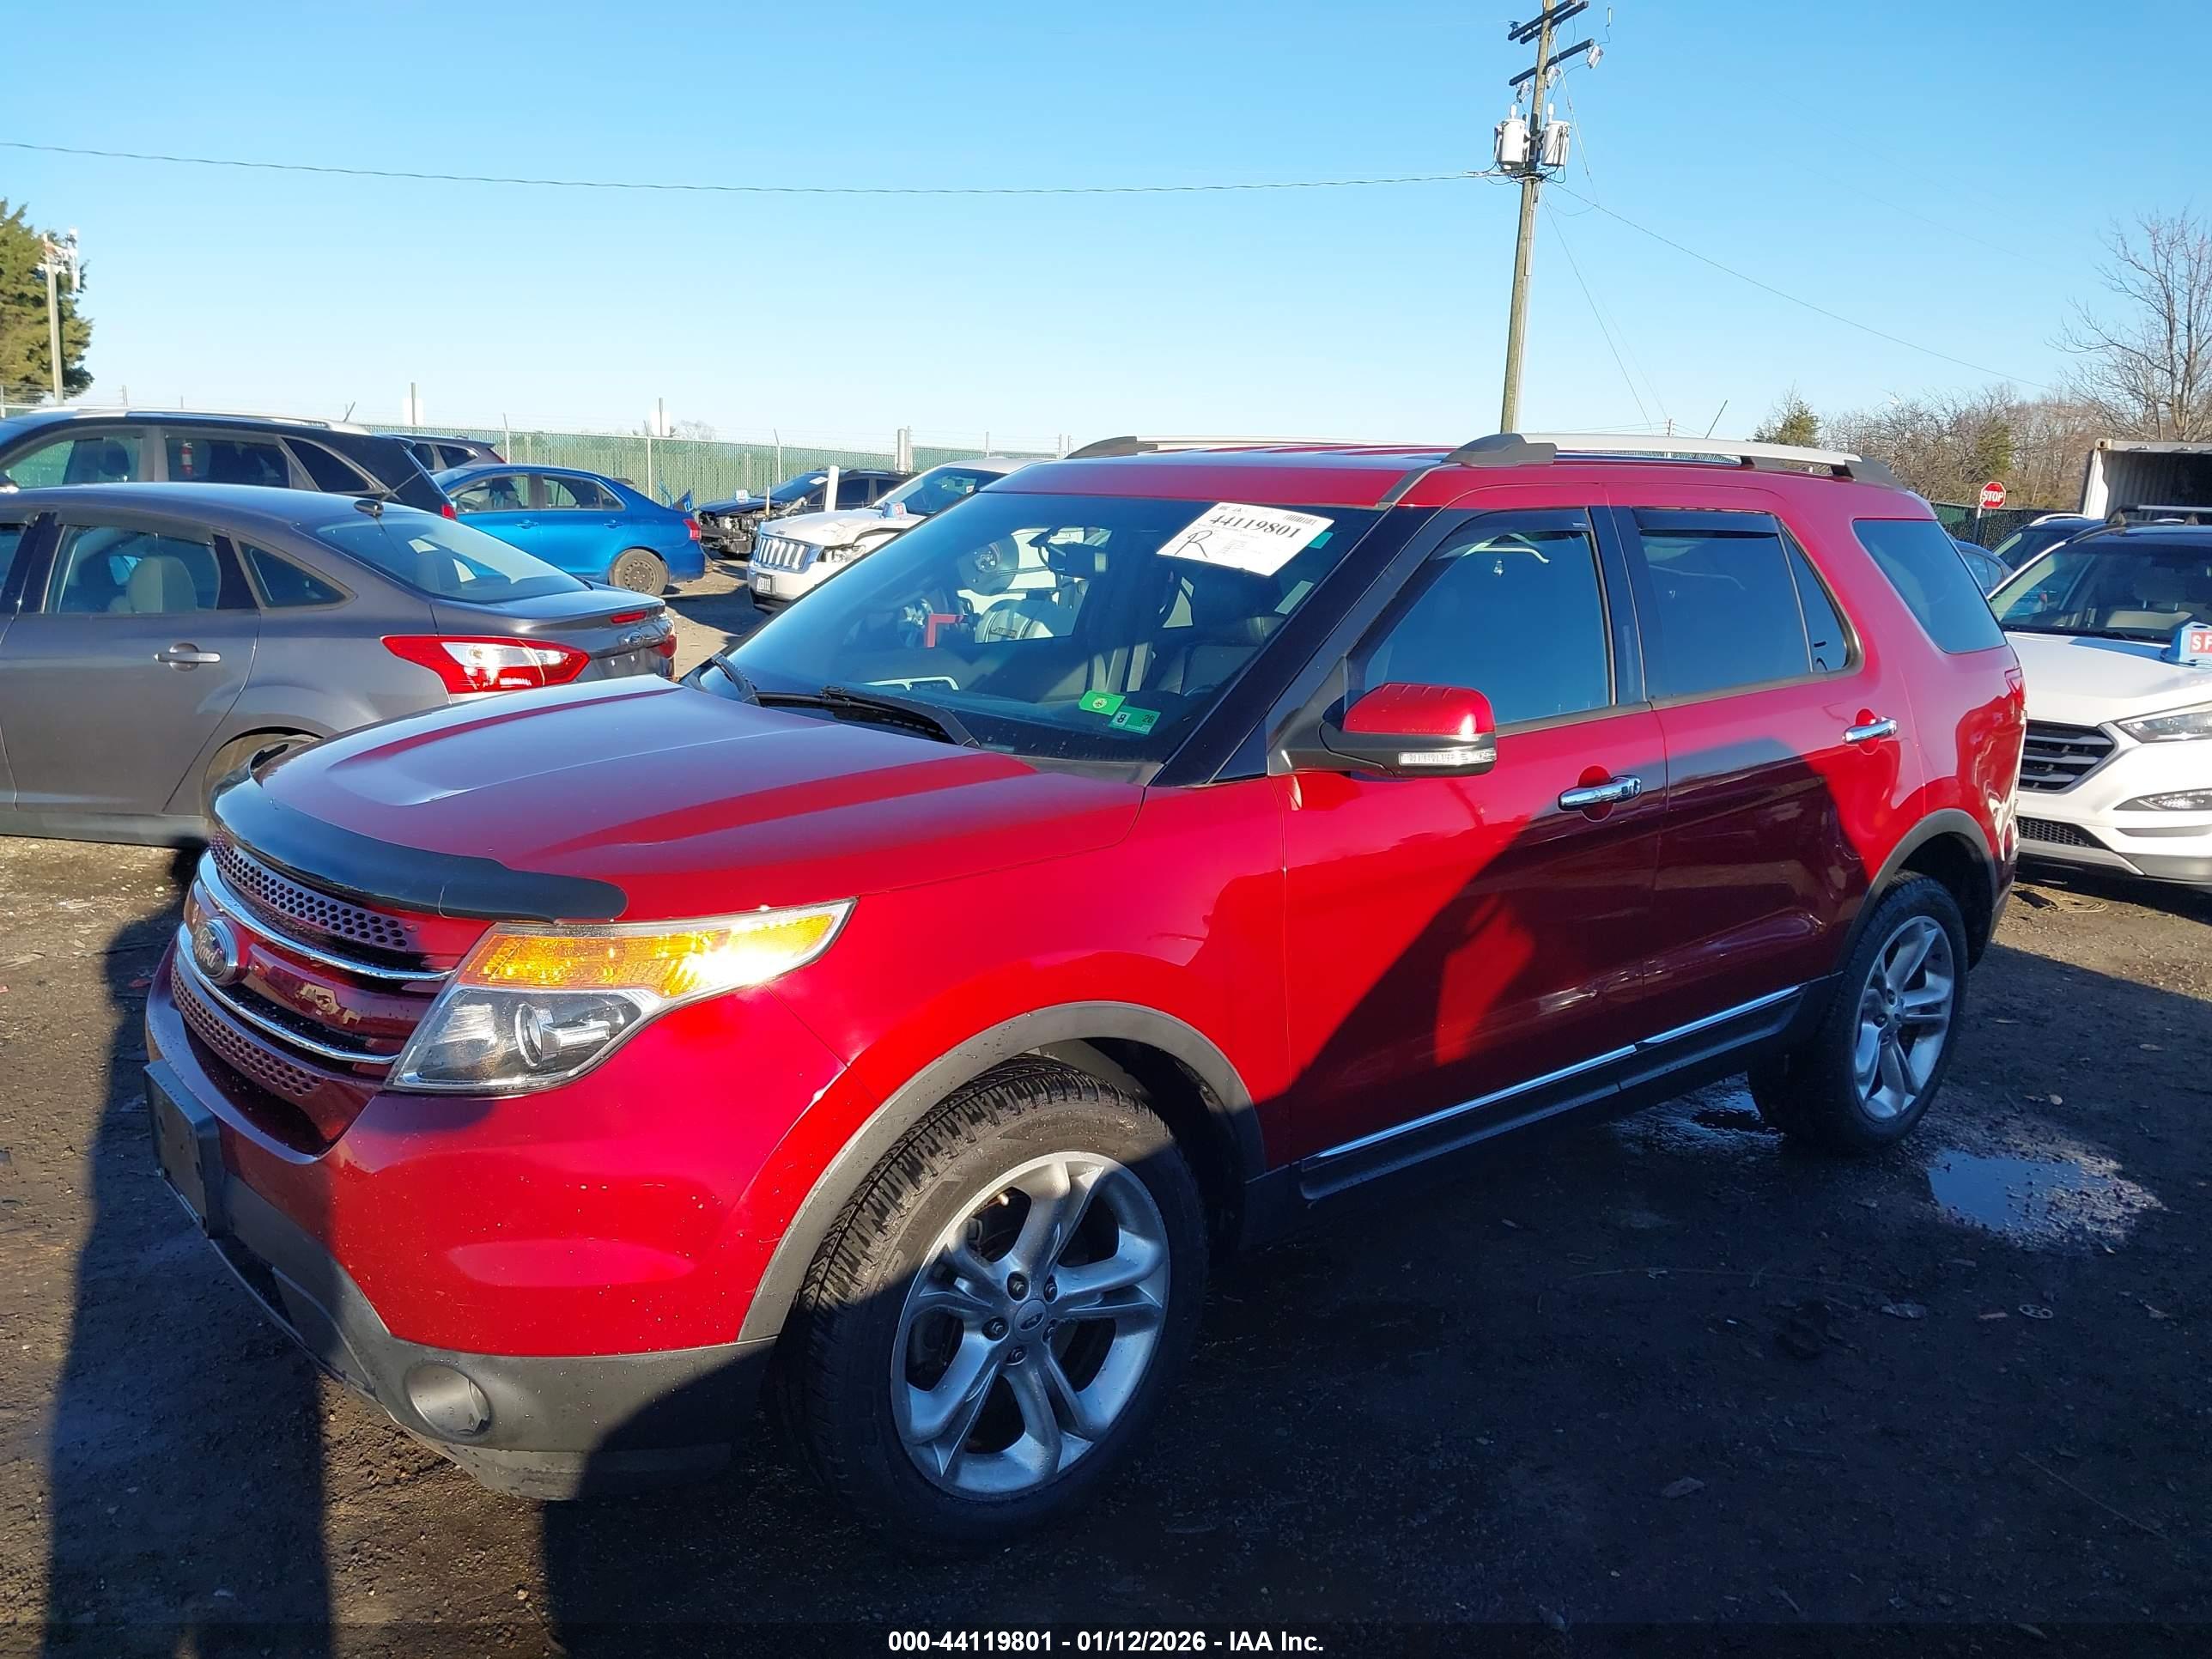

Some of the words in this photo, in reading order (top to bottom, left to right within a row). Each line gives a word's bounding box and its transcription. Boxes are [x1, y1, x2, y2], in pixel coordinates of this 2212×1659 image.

[1983, 490, 2004, 502] STOP
[1209, 514, 1302, 538] 44119801
[1174, 530, 1213, 558] R
